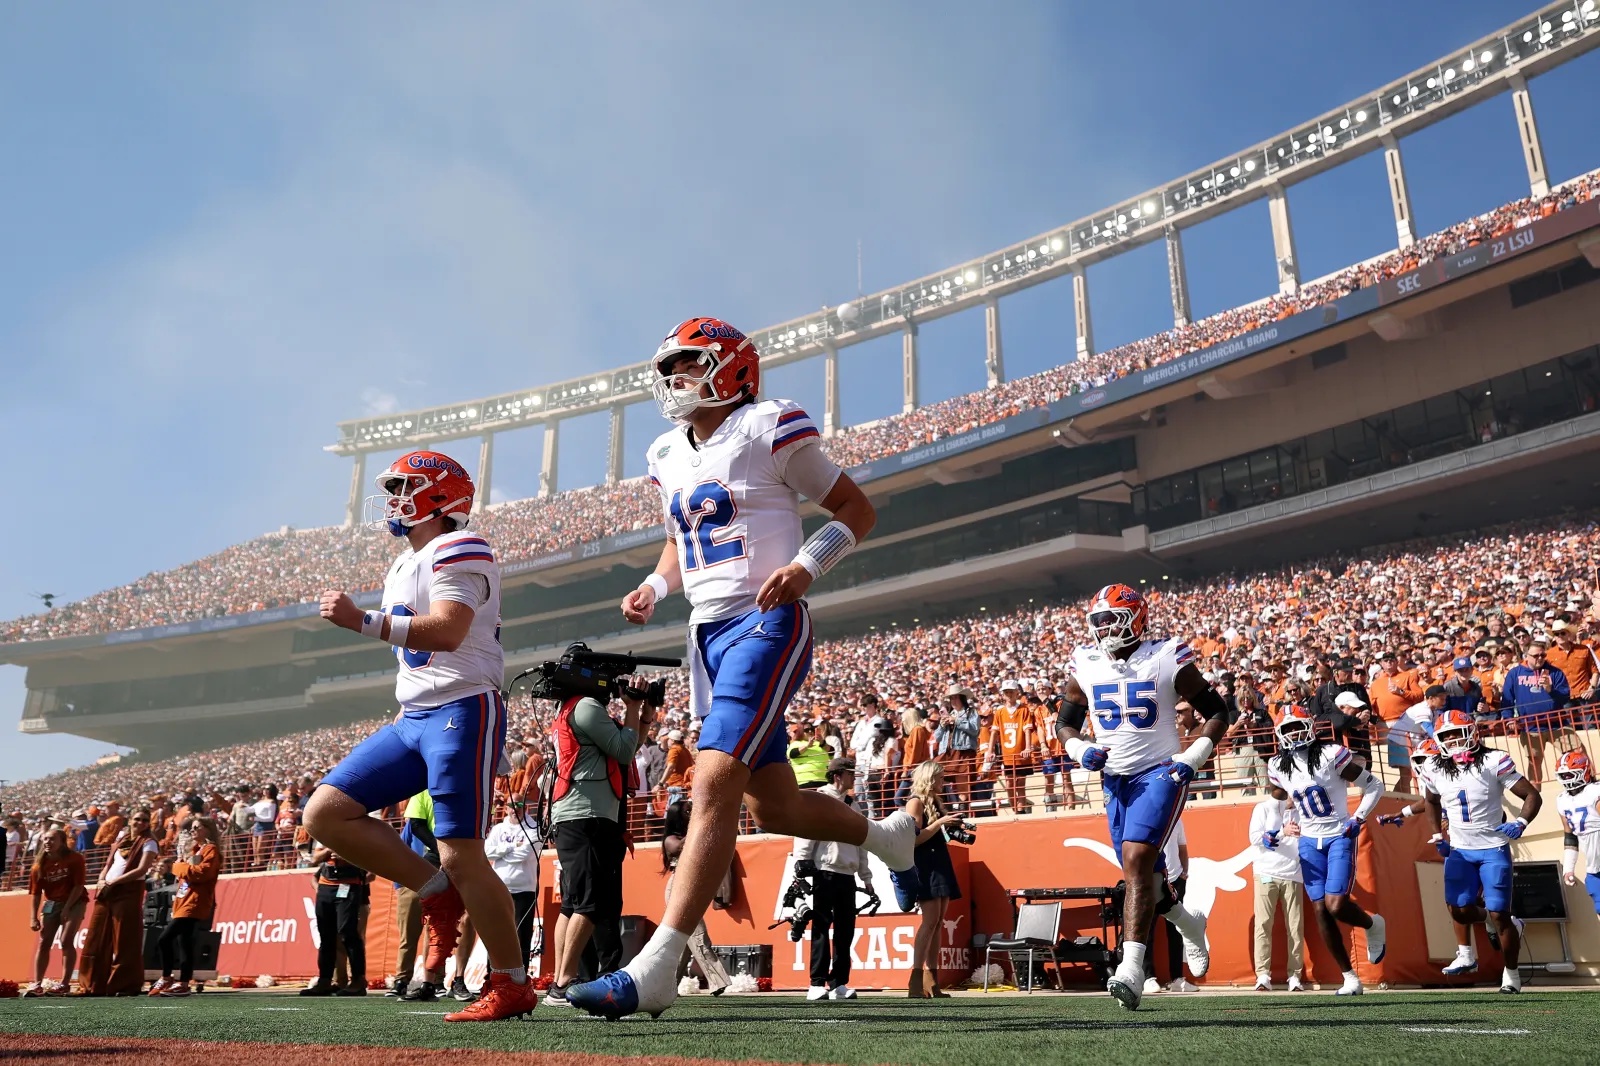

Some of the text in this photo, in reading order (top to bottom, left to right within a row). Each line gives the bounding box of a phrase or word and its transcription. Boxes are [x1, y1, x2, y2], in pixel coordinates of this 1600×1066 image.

[1491, 228, 1534, 257] 22 LSU
[1397, 273, 1421, 295] SEC
[1143, 328, 1278, 385] AMERICA'S #1 CHARCOAL BRAND
[408, 454, 464, 478] Gators
[670, 479, 749, 573] 12
[582, 543, 600, 558] 2:35
[1092, 680, 1159, 732] 55
[1003, 729, 1018, 748] 3
[1292, 785, 1334, 818] 10
[1456, 788, 1472, 824] 1
[210, 913, 297, 944] merican
